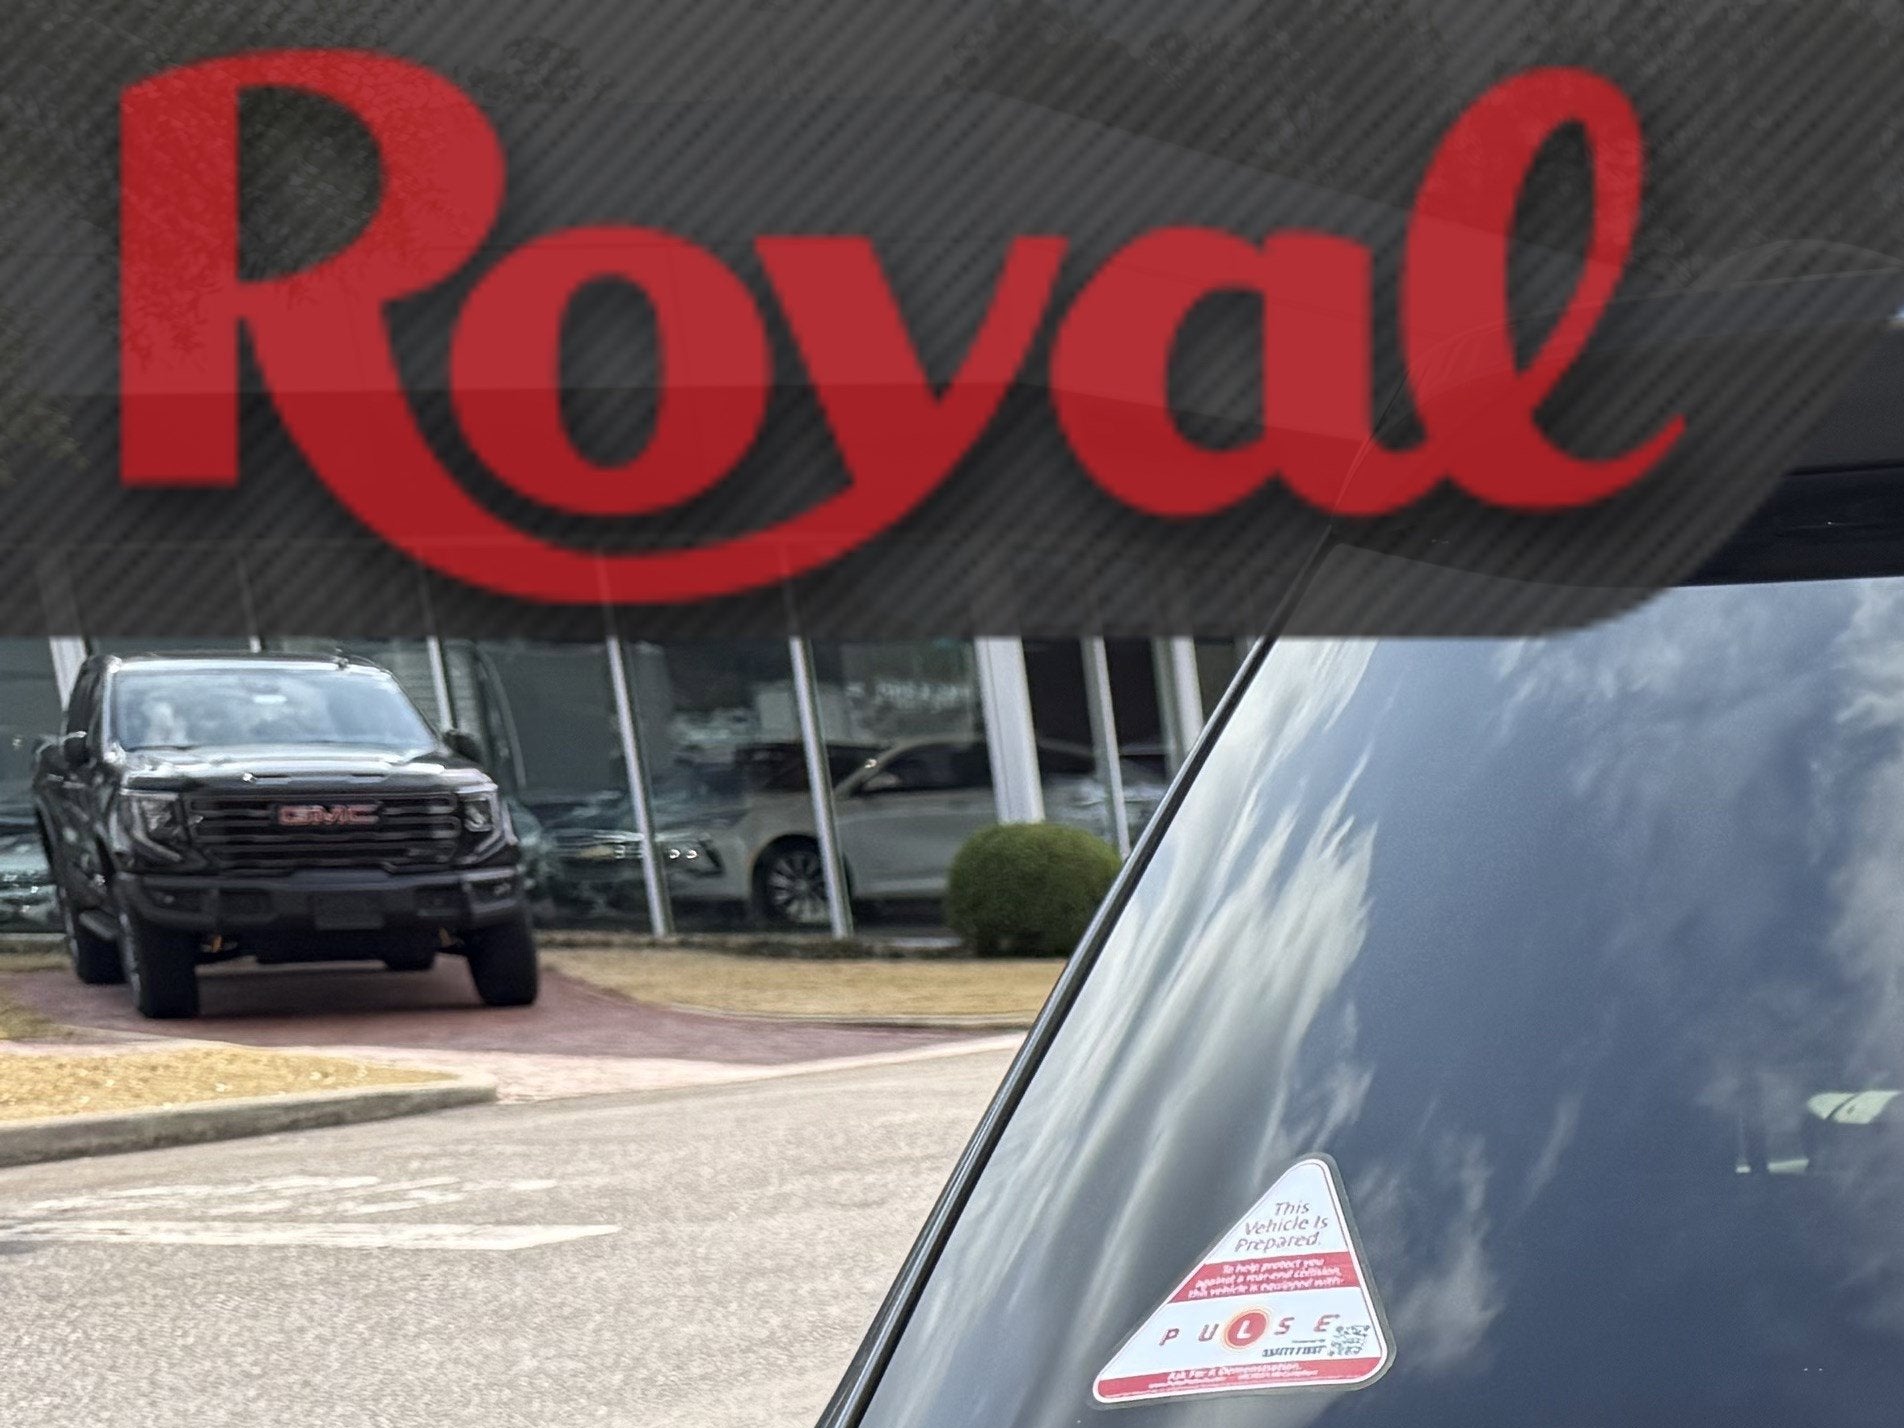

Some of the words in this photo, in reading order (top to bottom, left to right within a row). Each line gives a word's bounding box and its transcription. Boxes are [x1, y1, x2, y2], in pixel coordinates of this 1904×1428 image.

[278, 803, 380, 826] GMC
[1275, 1200, 1310, 1216] This
[1245, 1215, 1310, 1236] Vehicle
[1313, 1215, 1329, 1229] Is
